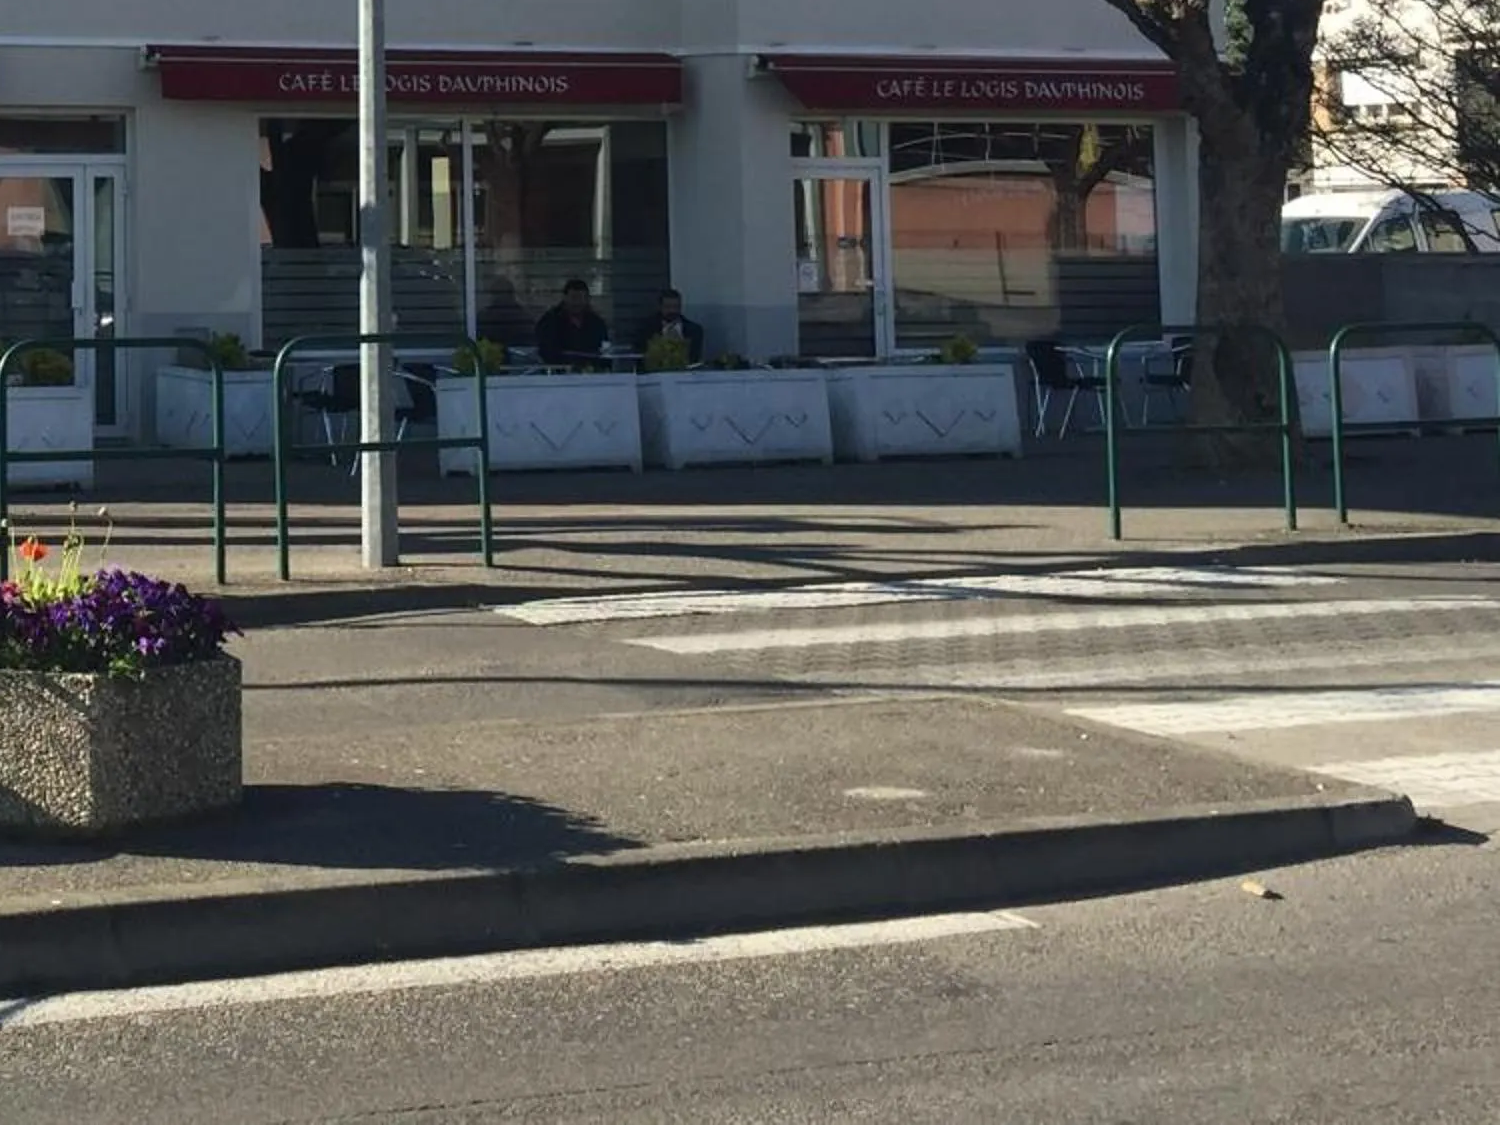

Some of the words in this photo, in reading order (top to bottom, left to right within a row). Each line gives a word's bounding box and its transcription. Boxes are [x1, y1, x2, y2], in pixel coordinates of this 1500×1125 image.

[278, 69, 334, 91] CAFÉ
[384, 74, 432, 93] OGIS
[438, 74, 569, 94] DAUPHINOIS
[876, 76, 926, 98] CAFÉ
[931, 80, 955, 98] LE
[960, 80, 1019, 99] LOGIS
[1024, 81, 1146, 101] DAUPHINOIS
